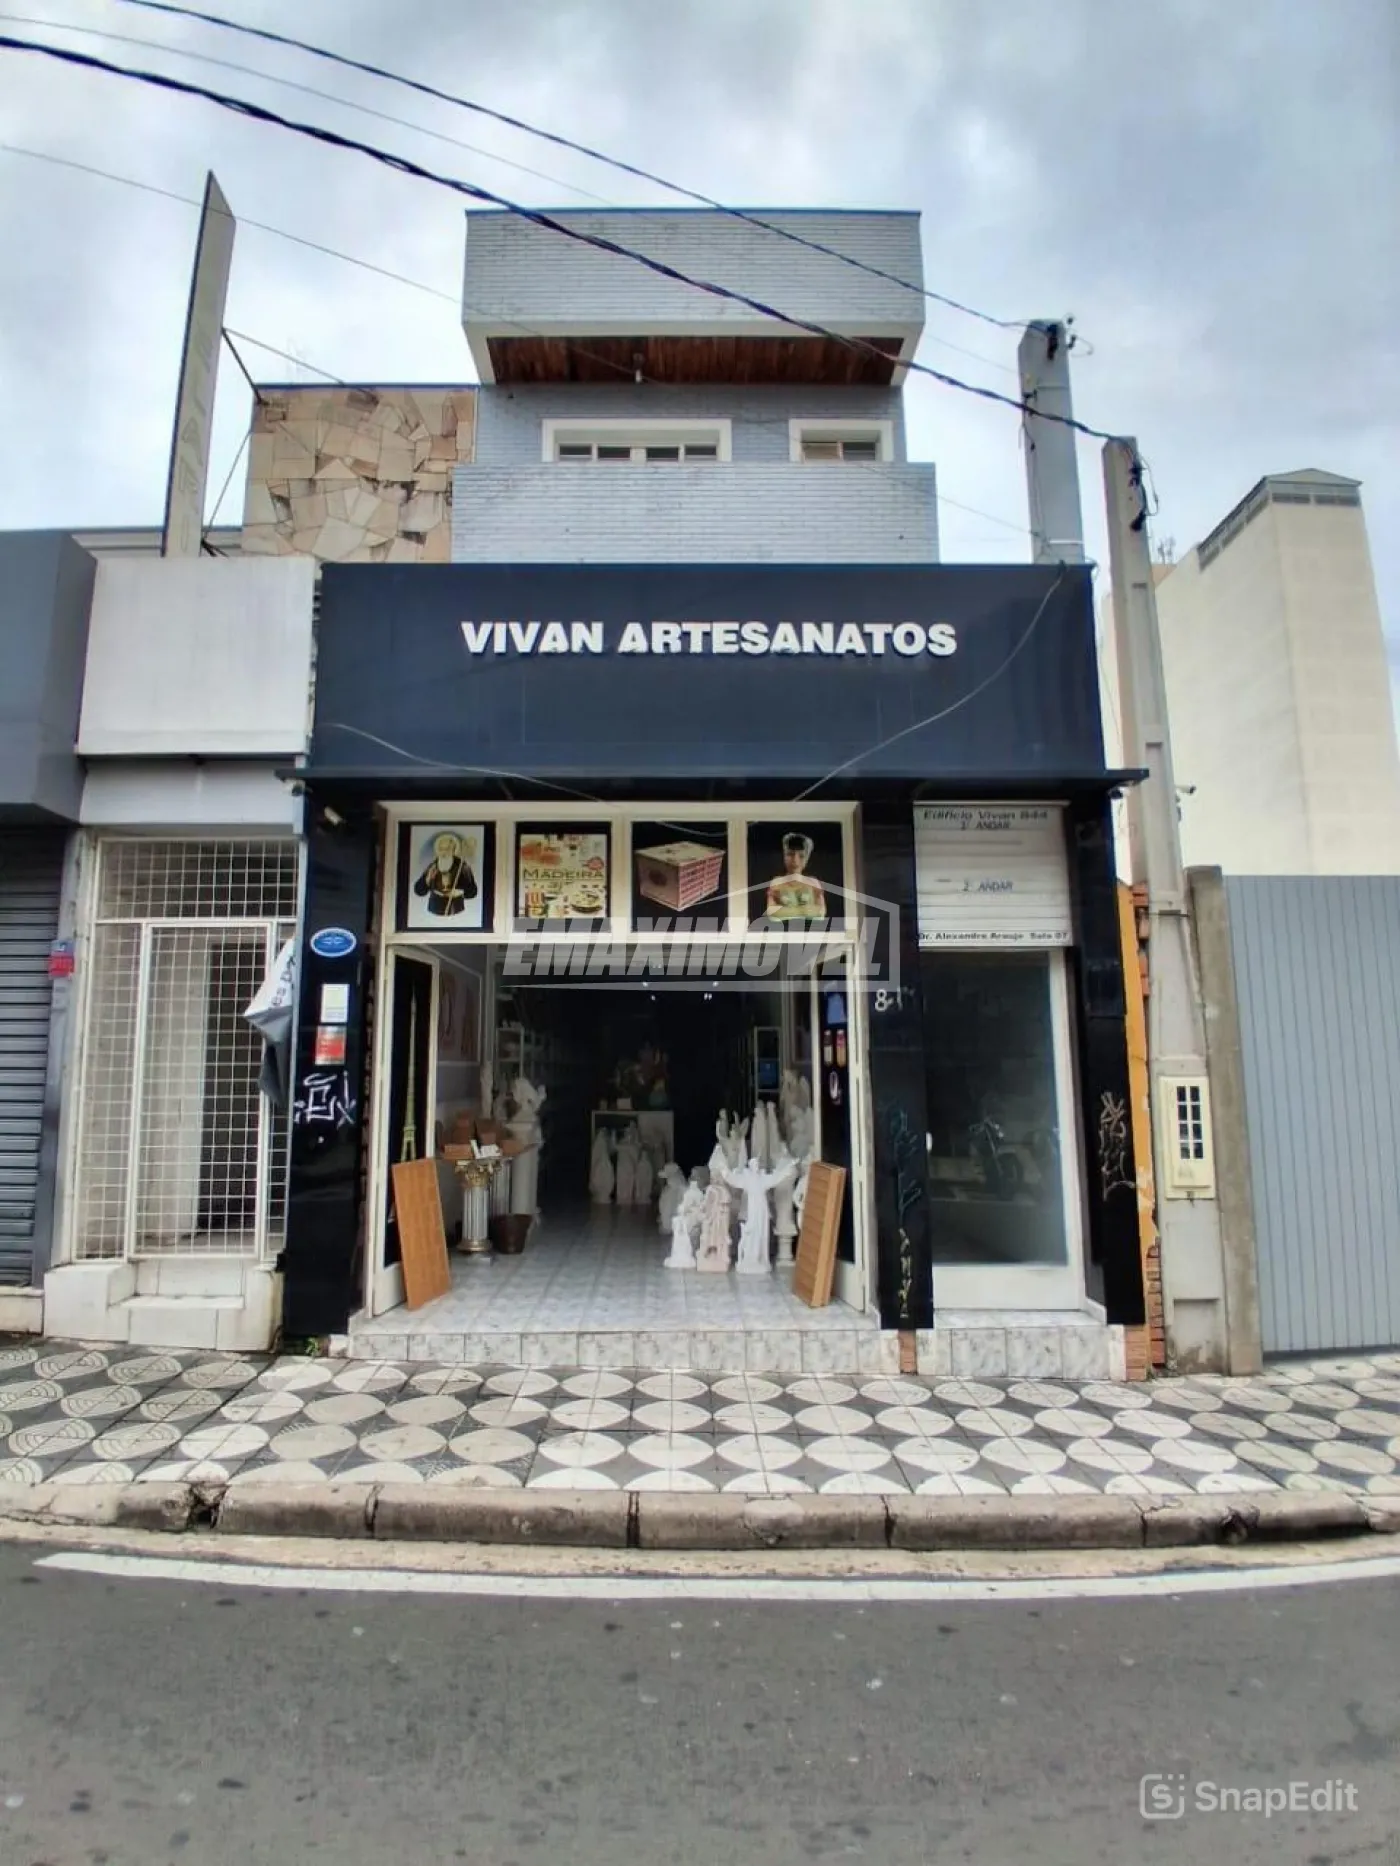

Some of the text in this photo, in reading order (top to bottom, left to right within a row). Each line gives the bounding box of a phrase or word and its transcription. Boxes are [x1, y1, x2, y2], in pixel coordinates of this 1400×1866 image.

[461, 620, 958, 658] VIVAN ARTESANATOS
[978, 807, 1015, 820] Vivan
[976, 819, 1011, 831] ANDAR
[978, 878, 1013, 891] ANDAR
